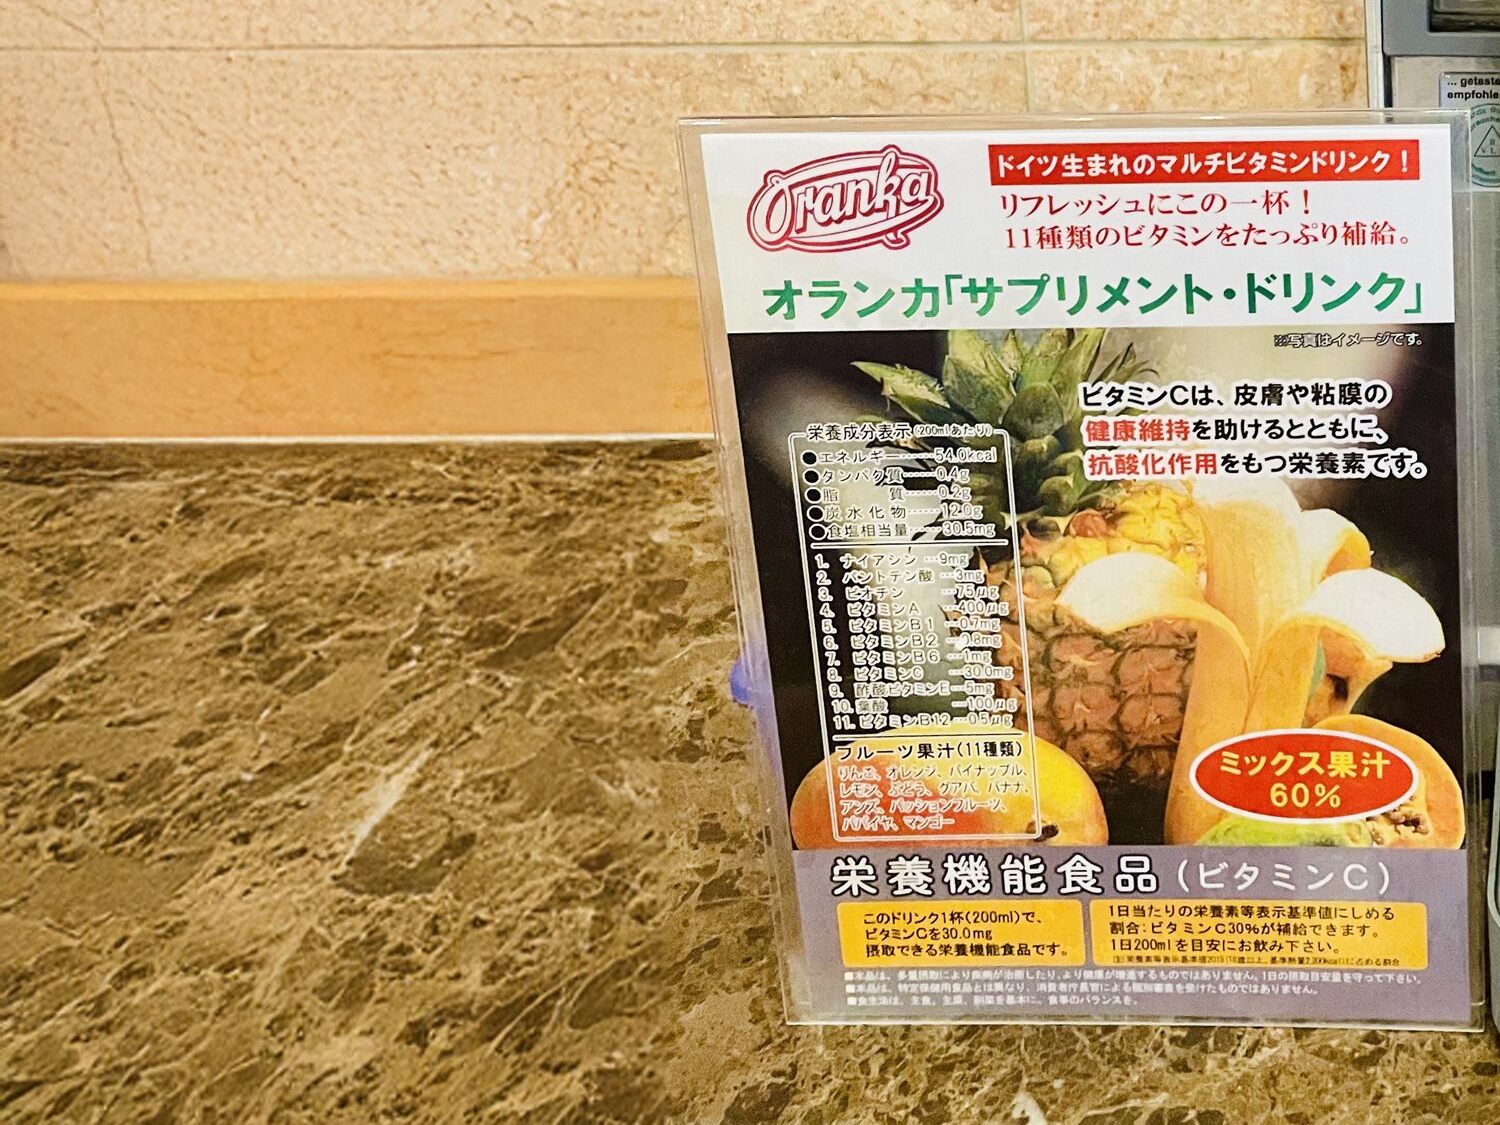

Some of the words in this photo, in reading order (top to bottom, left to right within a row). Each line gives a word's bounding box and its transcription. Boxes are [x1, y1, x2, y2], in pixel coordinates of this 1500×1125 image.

[998, 149, 1409, 178] ドイツ生まれのマルチビタミンドリンク！
[751, 150, 936, 245] Oranka
[1001, 189, 1311, 219] リフレッシュにこの一杯！
[1006, 221, 1410, 251] 11種類のビタミンをたっぷり補給。
[763, 271, 1422, 321] オランカ「サプリメント・ドリンク」
[1082, 382, 1388, 408] ビタミンCは、皮膚や粘膜の
[1086, 417, 1386, 442] 健康維持を助けるとともに、
[821, 450, 901, 464] エネルギー
[933, 447, 997, 463] 54.0kcal
[1088, 452, 1426, 477] 抗酸化作用をもつ栄養素です。
[822, 468, 904, 483] タンパク質
[935, 467, 970, 483] 0.4g
[937, 485, 972, 501] 0.2g
[827, 524, 908, 539] 食塩相当量
[840, 553, 917, 567] ナイアシン
[847, 602, 920, 617] ビタミンA
[1220, 750, 1391, 779] ミックス果汁
[1270, 783, 1341, 808] 60%
[866, 943, 1068, 958] 摂取できる栄養機能食品です。
